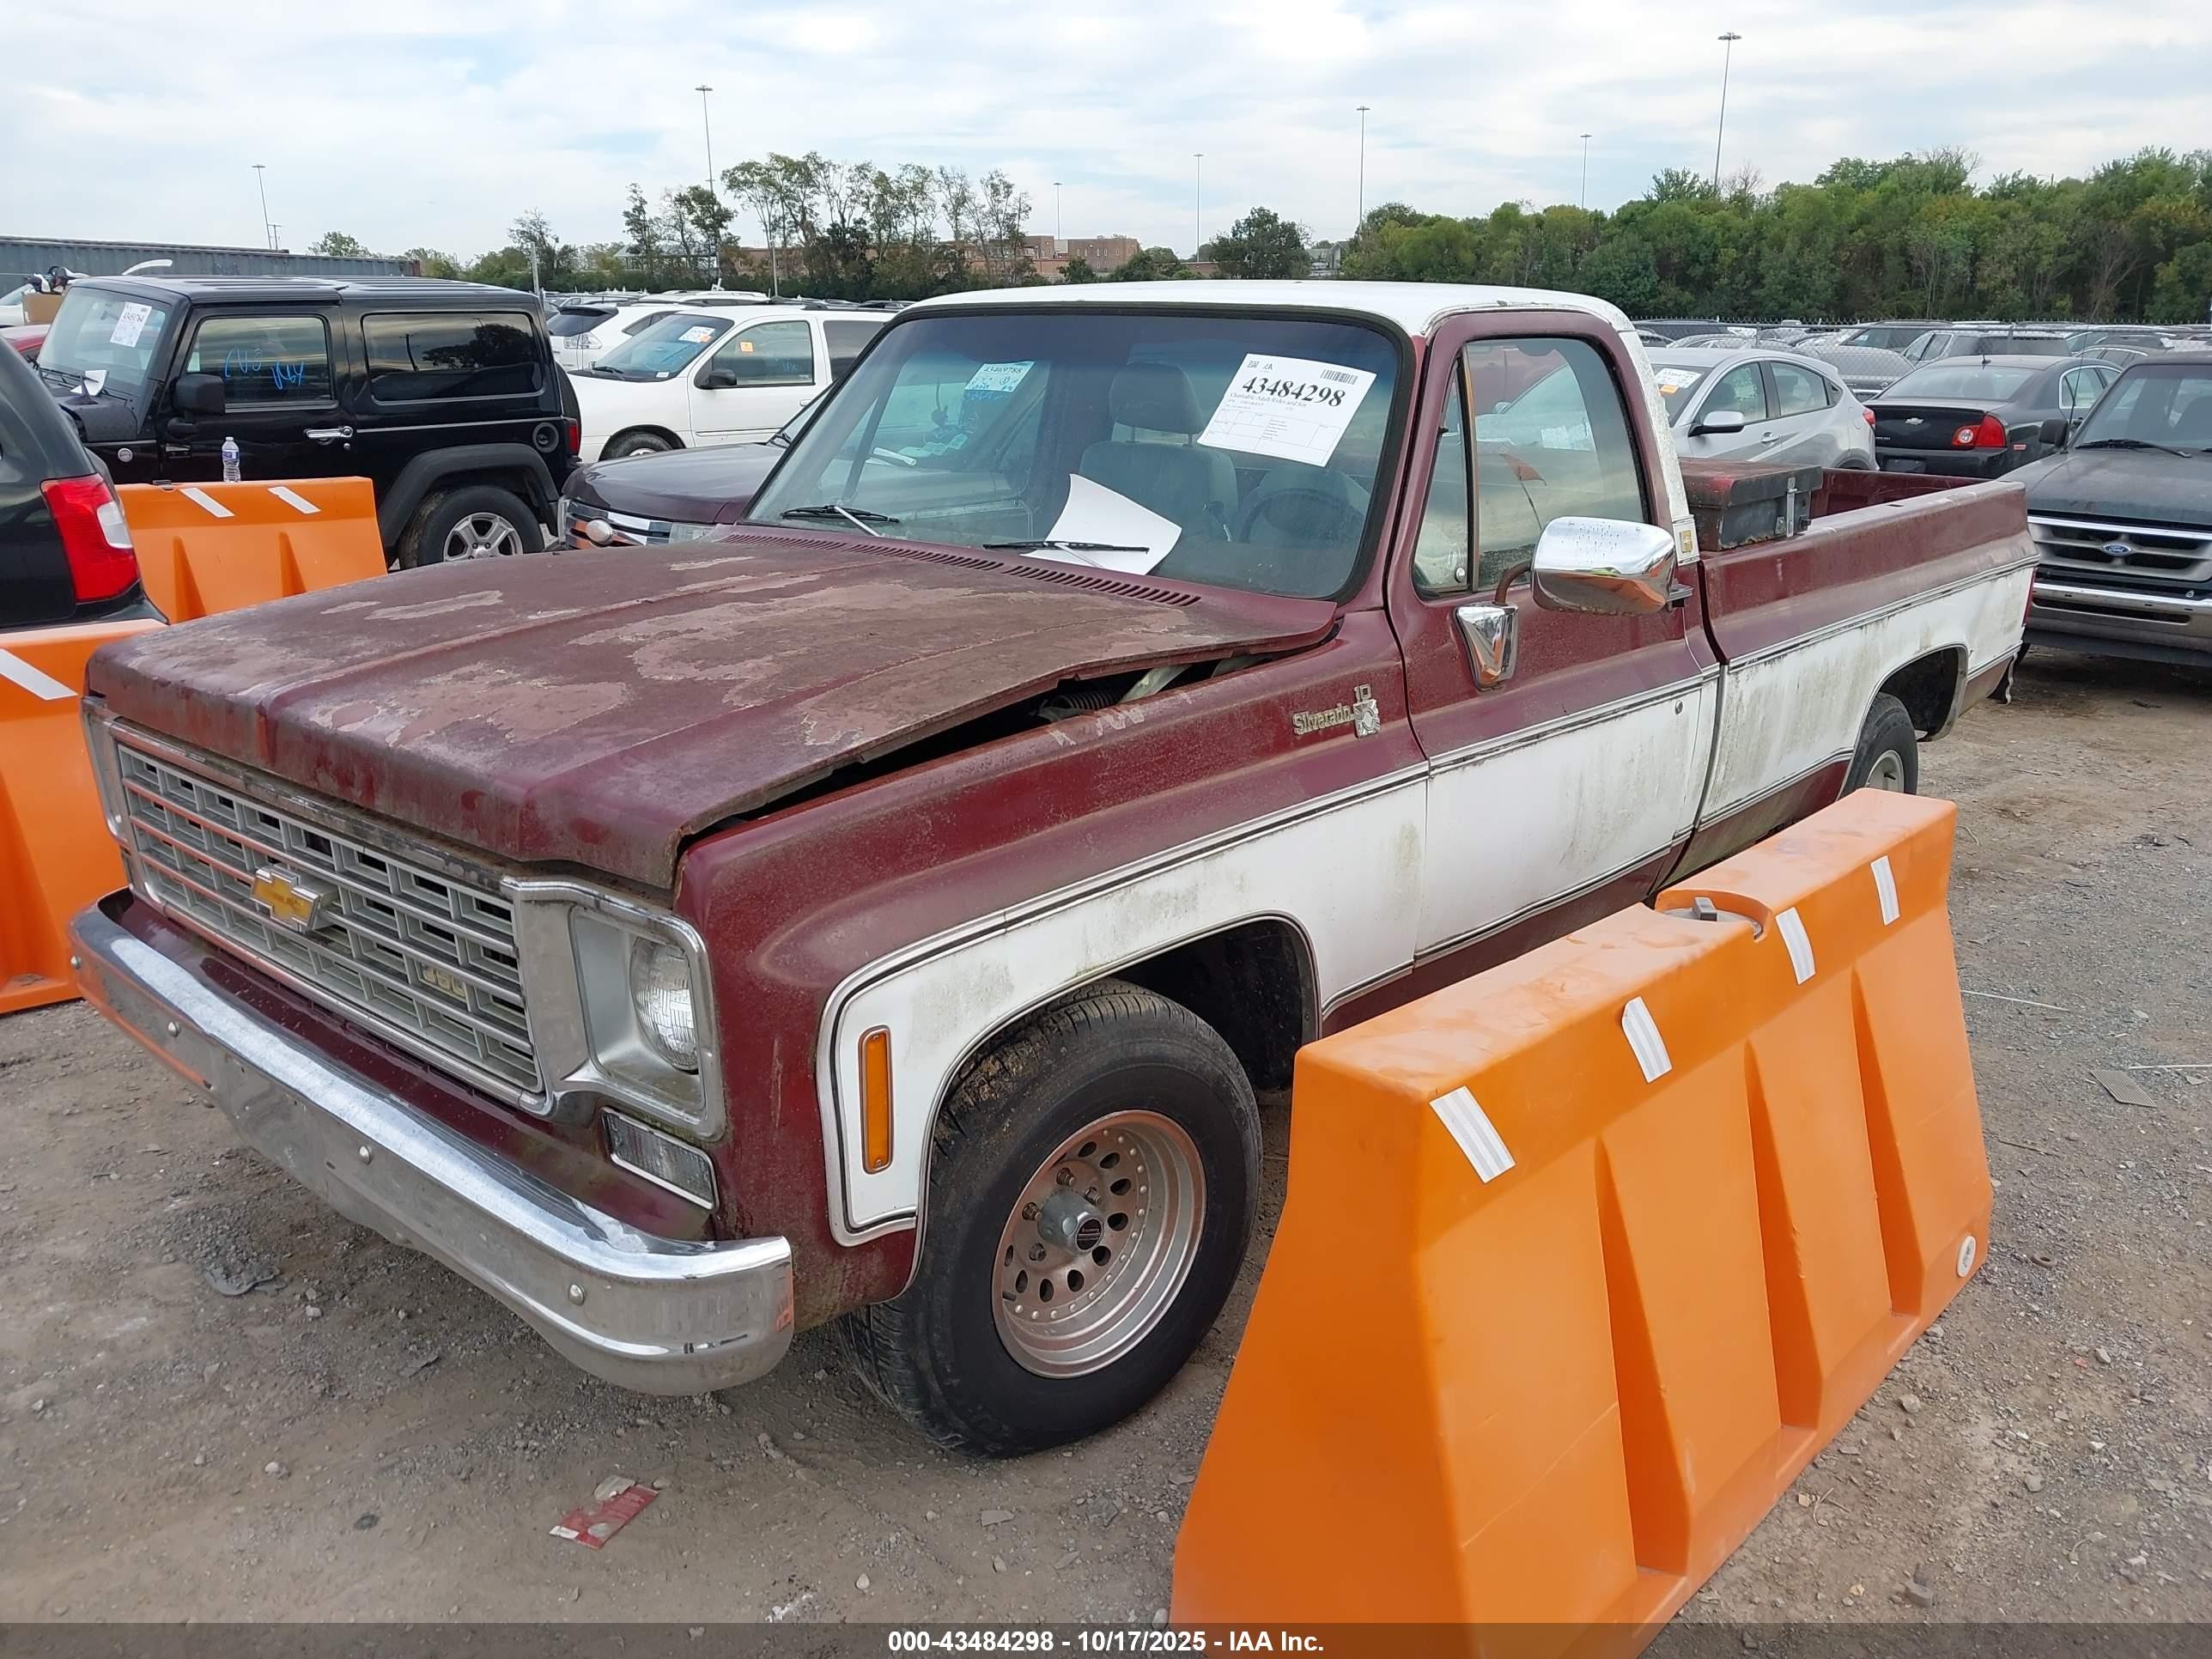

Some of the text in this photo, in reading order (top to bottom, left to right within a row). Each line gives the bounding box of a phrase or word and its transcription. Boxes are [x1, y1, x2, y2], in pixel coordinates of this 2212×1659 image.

[1243, 376, 1346, 406] 43484298
[1353, 684, 1372, 702] 10
[1292, 702, 1354, 735] Silverado
